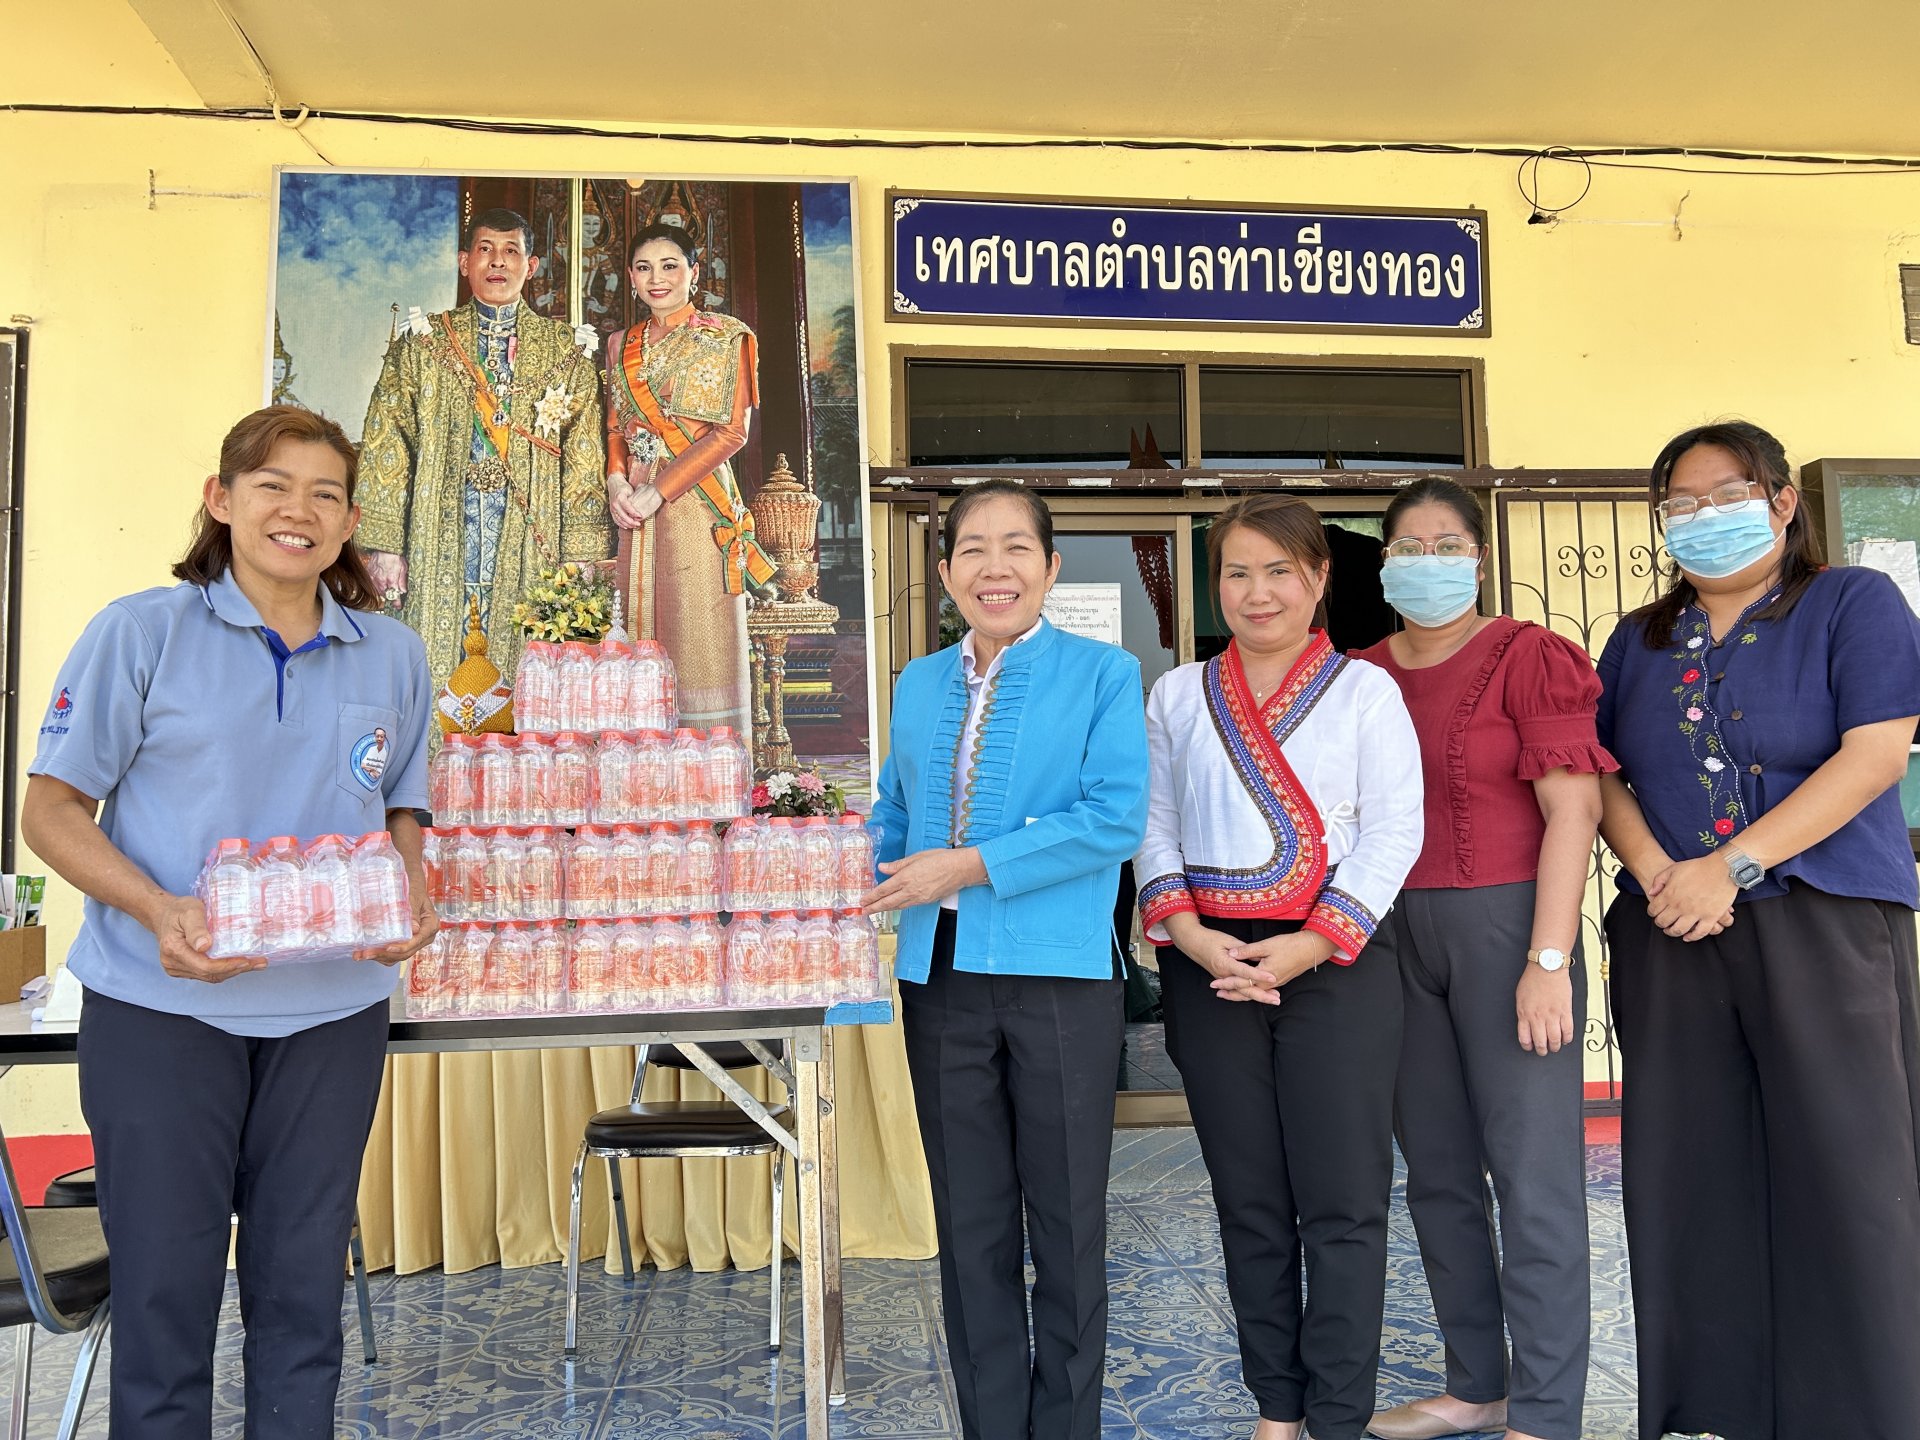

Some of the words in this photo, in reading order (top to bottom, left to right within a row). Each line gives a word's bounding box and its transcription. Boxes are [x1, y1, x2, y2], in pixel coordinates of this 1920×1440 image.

[915, 217, 1466, 299] เทศบาลตำบลท่าเชียงทอง
